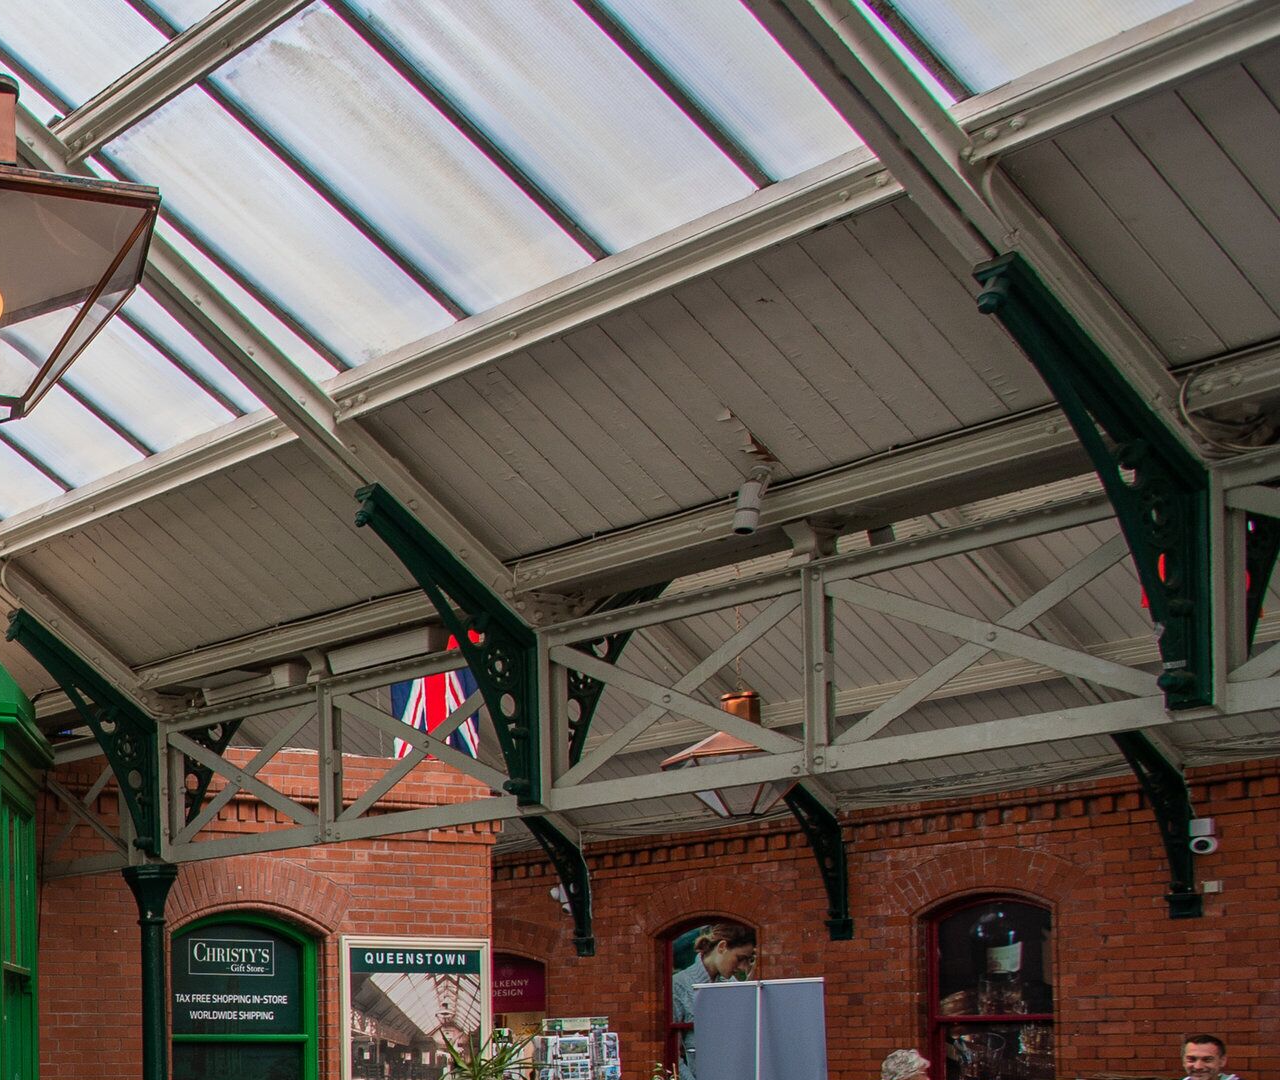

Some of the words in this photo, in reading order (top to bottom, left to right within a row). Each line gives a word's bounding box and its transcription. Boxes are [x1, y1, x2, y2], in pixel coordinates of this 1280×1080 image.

[364, 952, 466, 965] QUEENSTOWN
[230, 963, 245, 972] Gift
[246, 964, 265, 973] Store
[494, 979, 529, 988] LKENNY
[175, 994, 190, 1003] TAX
[191, 994, 211, 1003] FREE
[212, 994, 251, 1004] SHOPPING
[252, 995, 287, 1004] IN-STORE
[189, 1011, 238, 1020] WORLDWIDE
[238, 1011, 274, 1020] SHIPPING
